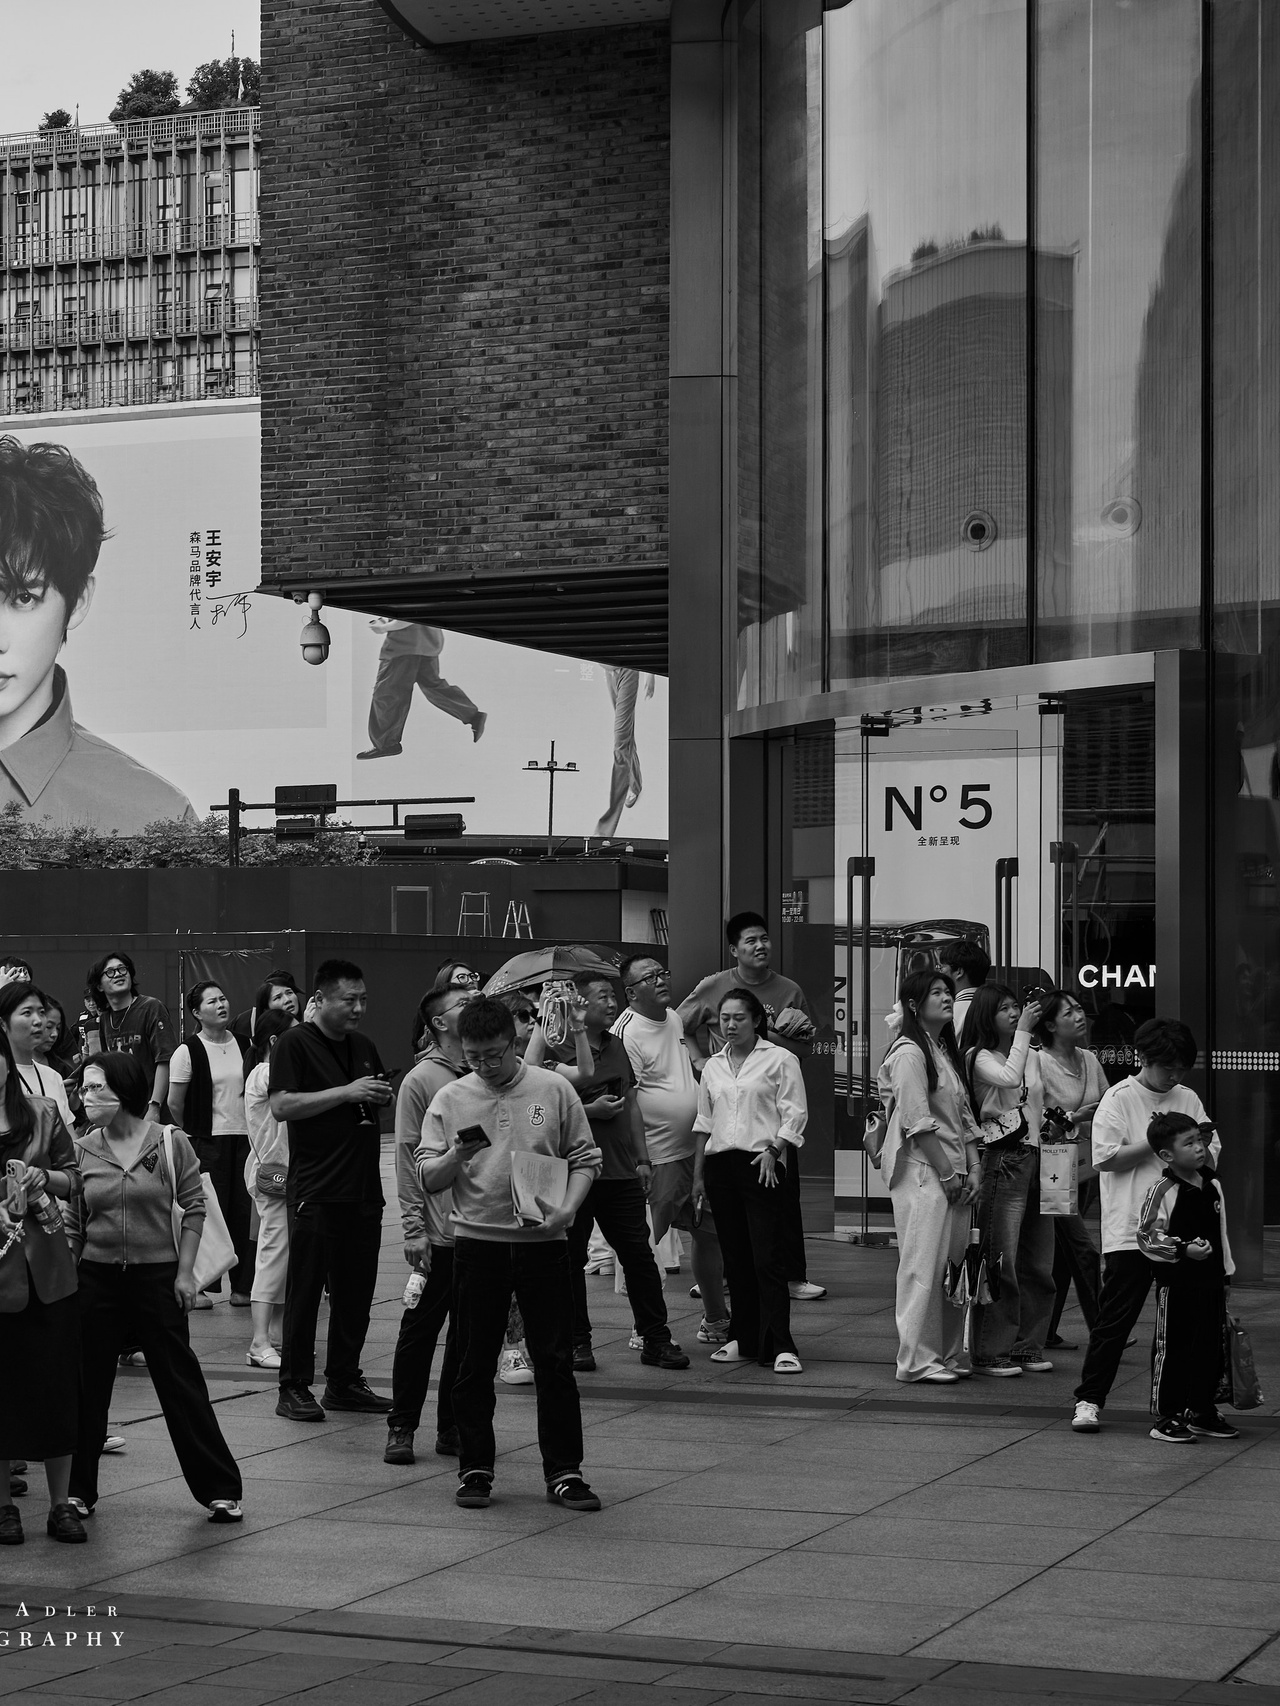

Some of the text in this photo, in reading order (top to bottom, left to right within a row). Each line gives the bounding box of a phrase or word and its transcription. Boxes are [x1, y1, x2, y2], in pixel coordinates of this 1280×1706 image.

[189, 531, 201, 630] 森马品牌代言人
[205, 529, 222, 588] 王安宇
[917, 836, 960, 847] 全新呈现
